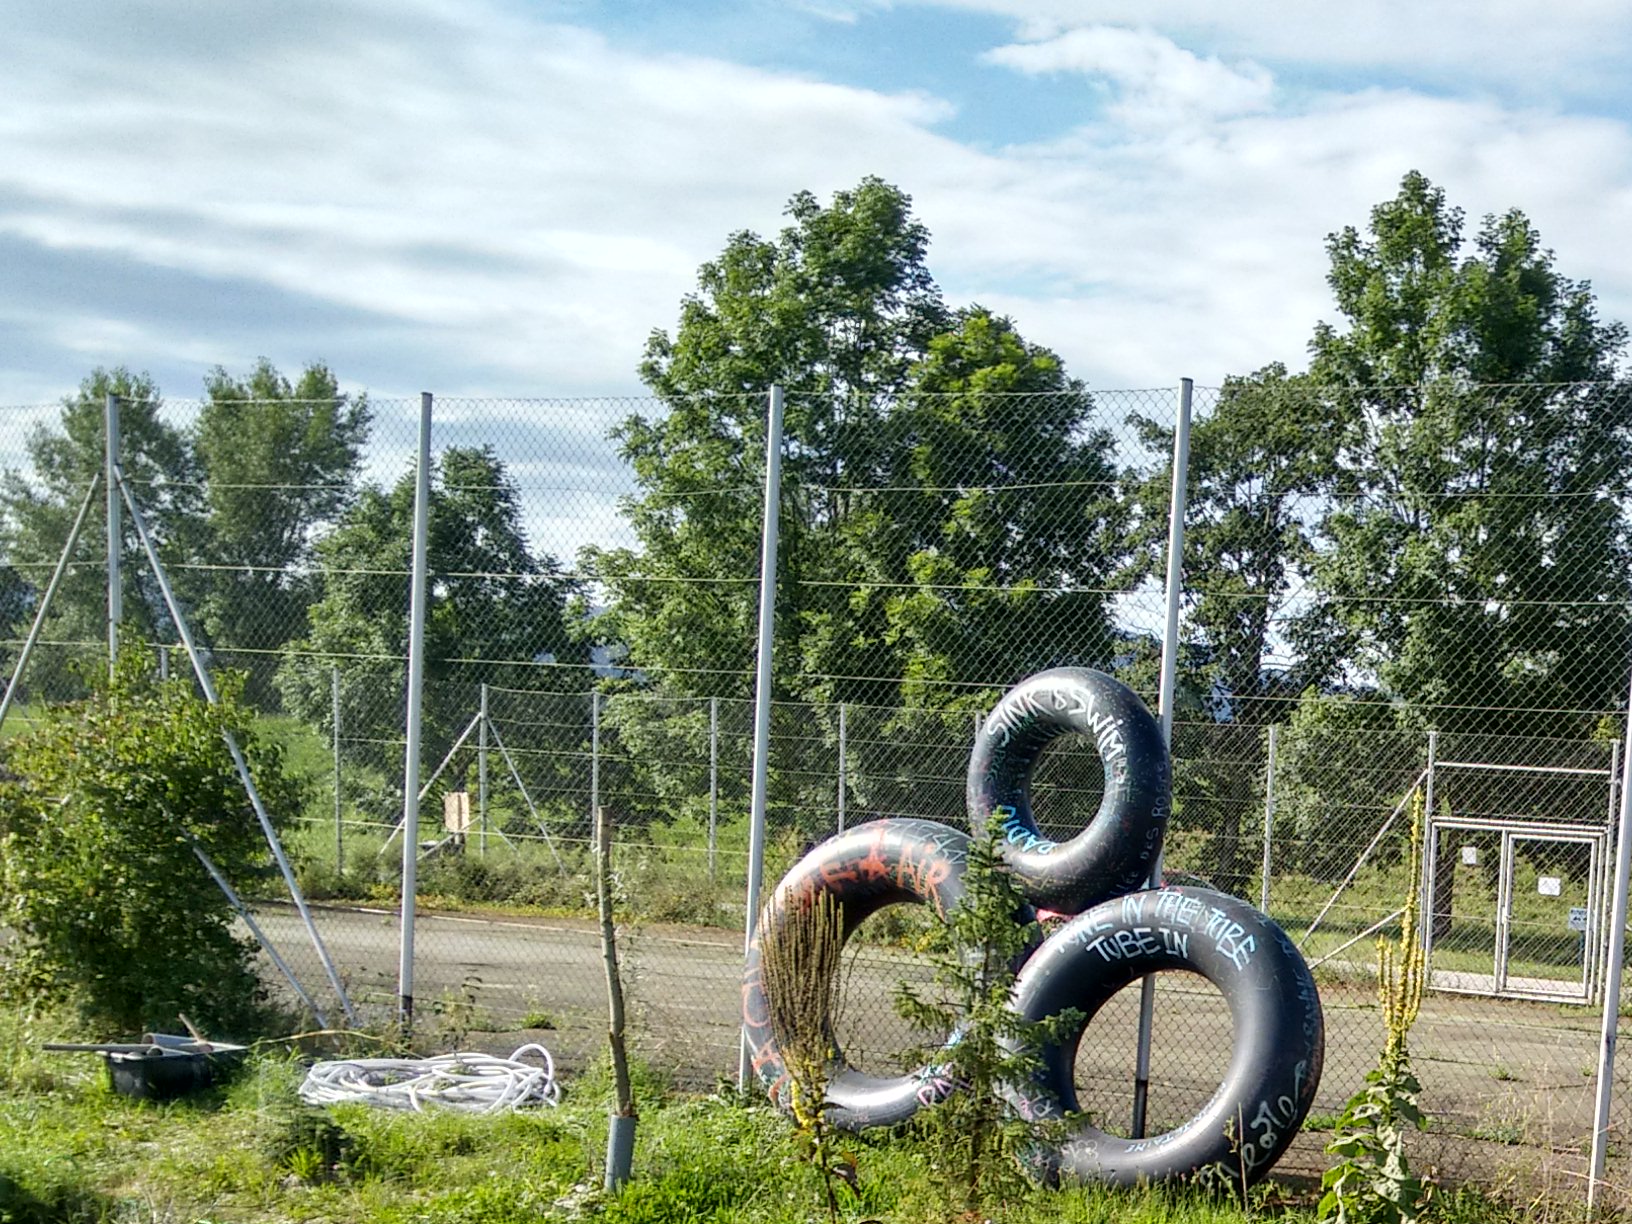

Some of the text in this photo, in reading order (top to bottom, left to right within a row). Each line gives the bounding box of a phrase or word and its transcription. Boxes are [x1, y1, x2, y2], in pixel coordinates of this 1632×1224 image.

[987, 689, 1055, 748] SINK
[1086, 926, 1189, 962] TUBE IN
[1121, 894, 1148, 926] IN
[1205, 907, 1257, 972] TUBE
